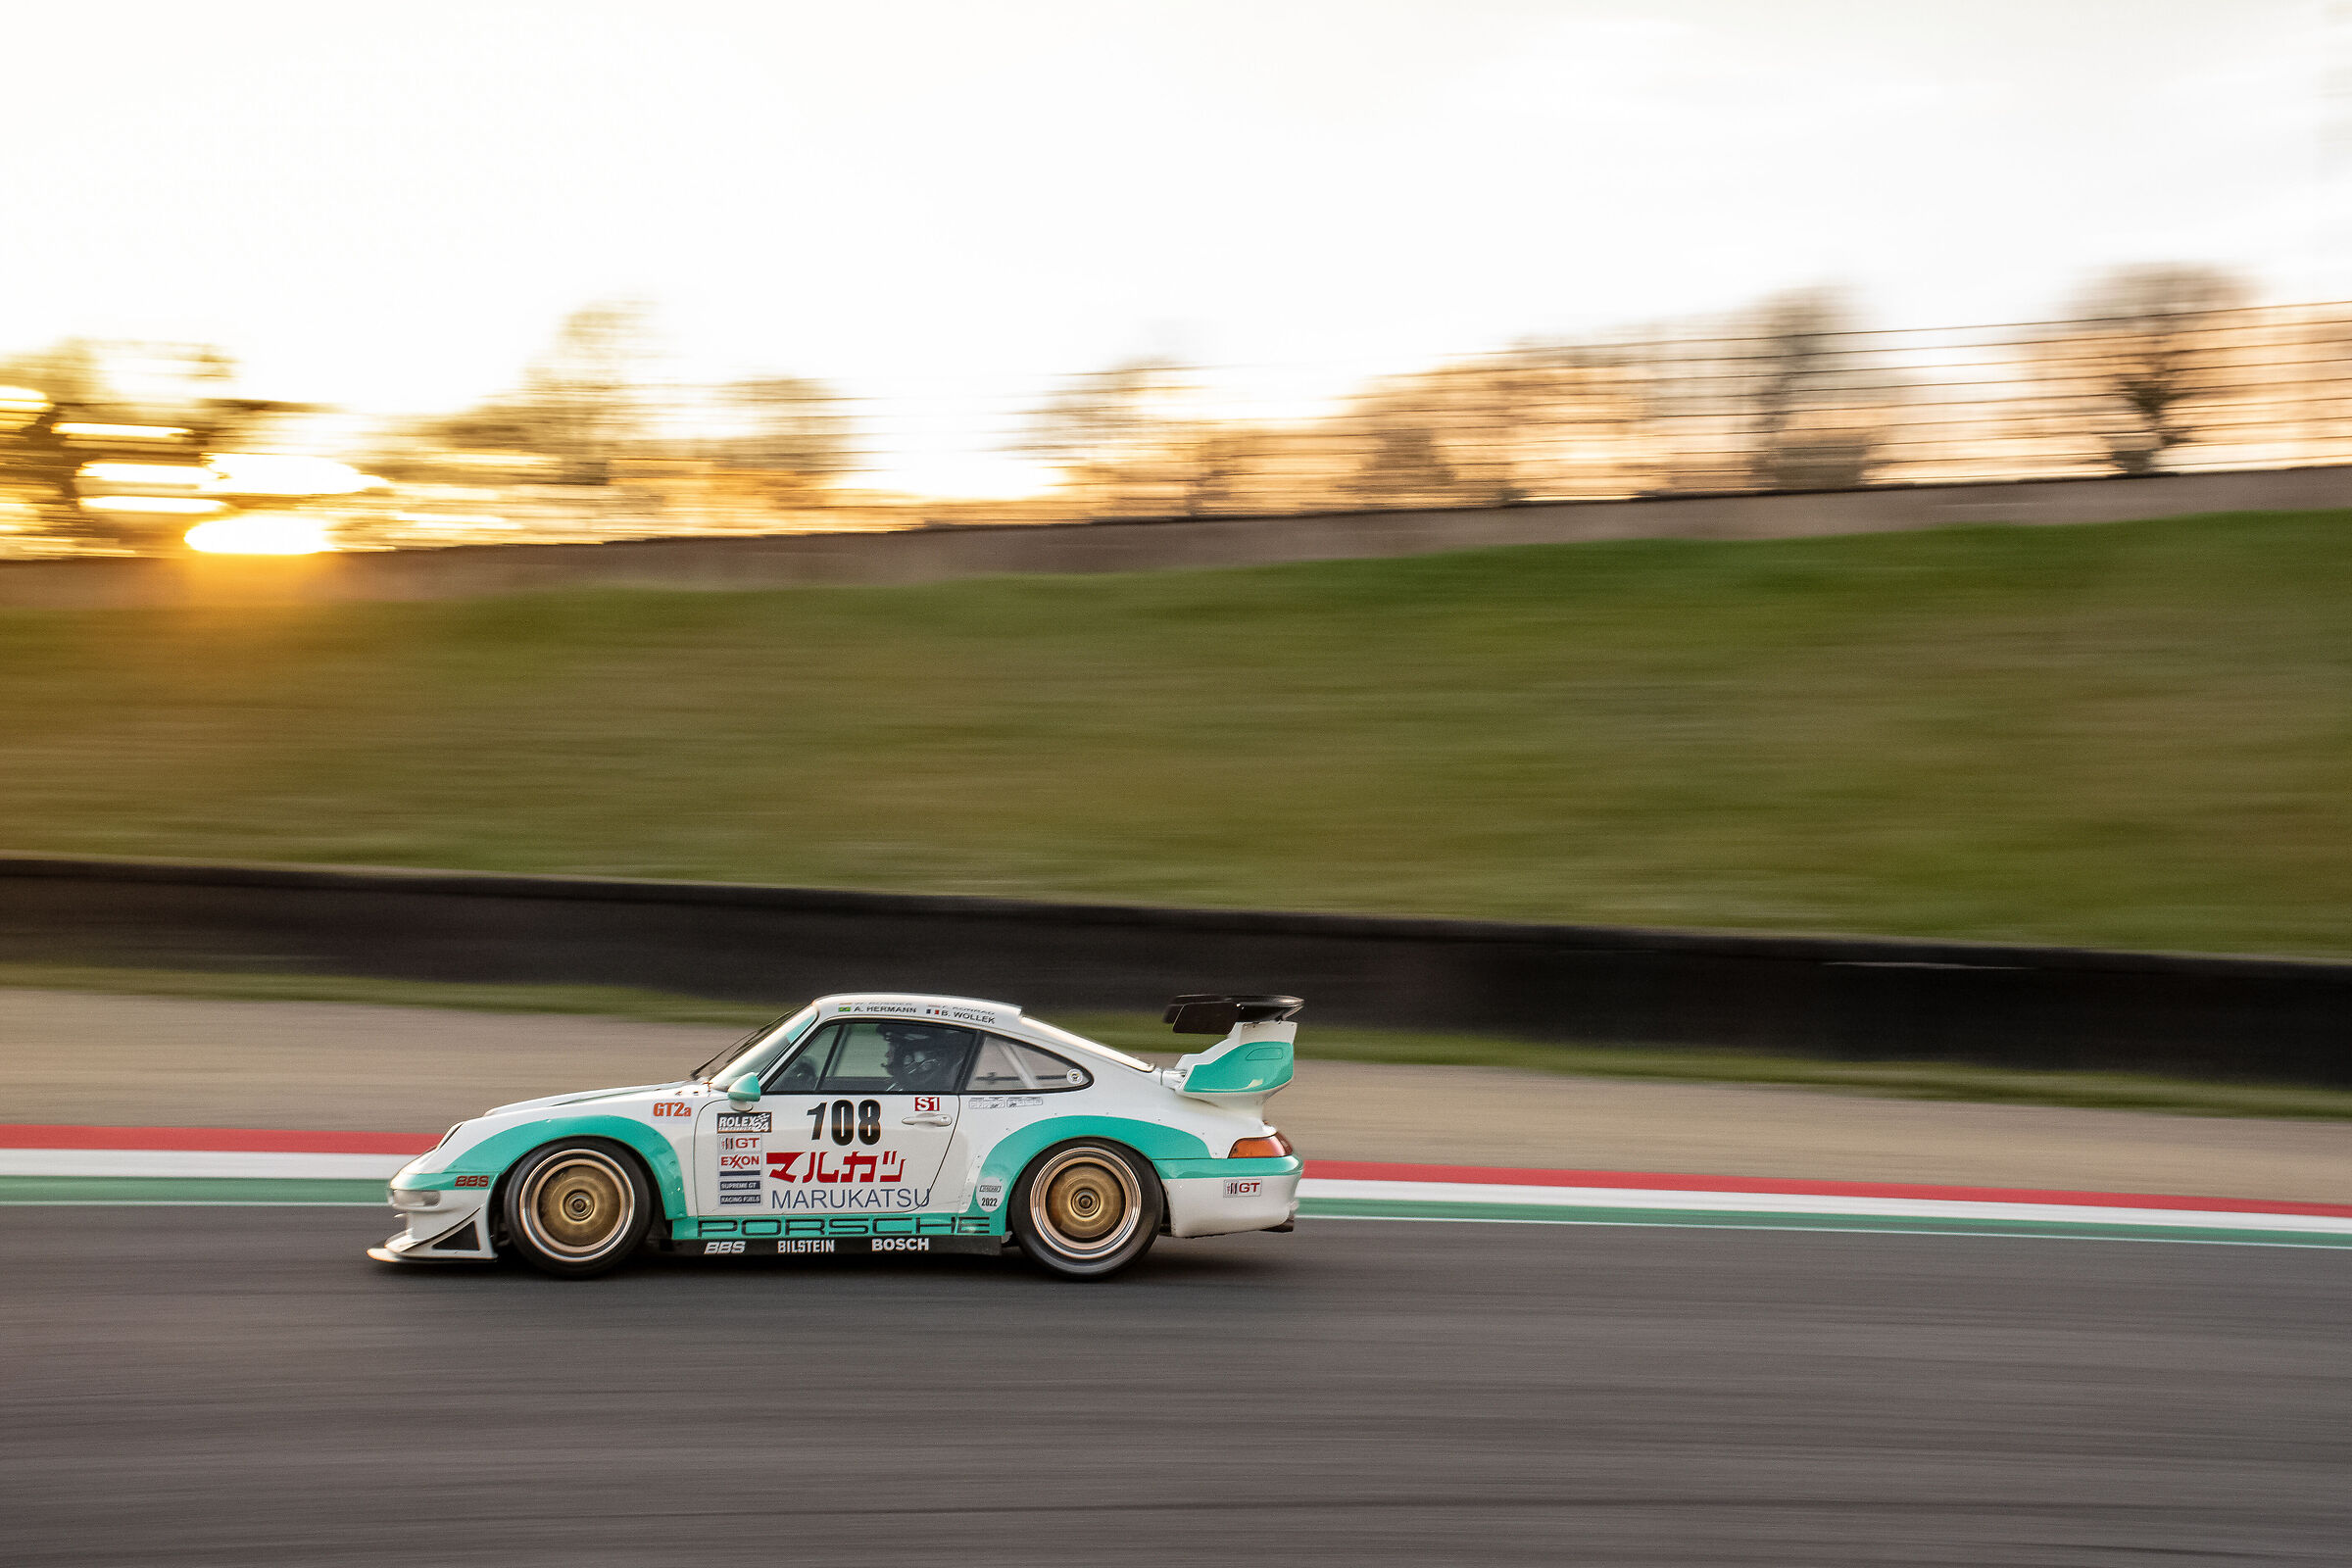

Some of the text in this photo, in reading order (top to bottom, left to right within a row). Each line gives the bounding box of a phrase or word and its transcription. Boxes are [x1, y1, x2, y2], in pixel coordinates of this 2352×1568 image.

[954, 1010, 996, 1024] WOLLEK
[653, 1102, 692, 1117] GT2a
[916, 1097, 939, 1111] S1
[719, 1116, 756, 1127] ROLEX
[807, 1099, 881, 1146] 108
[720, 1154, 760, 1169] EXXON
[766, 1151, 906, 1184] マルカツ
[455, 1175, 489, 1188] BBS
[771, 1188, 931, 1209] MARUKATSU
[981, 1197, 998, 1207] 2022
[698, 1216, 990, 1238] PORSCHE
[704, 1241, 746, 1254] BBS
[777, 1240, 835, 1253] BILSTEIN
[871, 1238, 930, 1252] BOSCH
